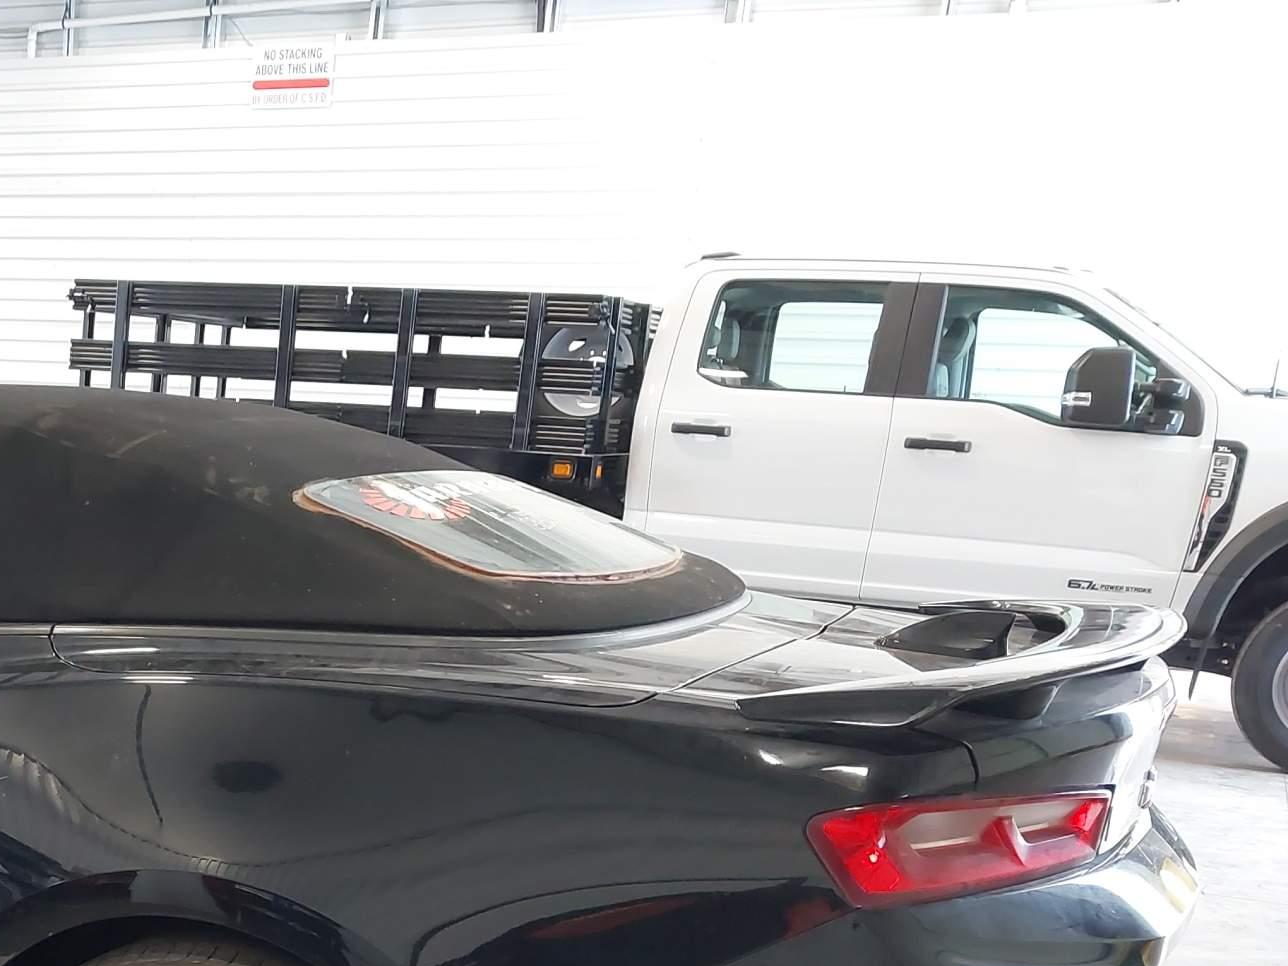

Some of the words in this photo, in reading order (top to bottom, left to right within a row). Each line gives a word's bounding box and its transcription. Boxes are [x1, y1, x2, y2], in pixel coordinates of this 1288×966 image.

[264, 49, 277, 61] NO
[279, 48, 322, 60] STACKING
[256, 64, 283, 76] ABOVE
[288, 63, 307, 74] THIS
[309, 62, 328, 73] LINE
